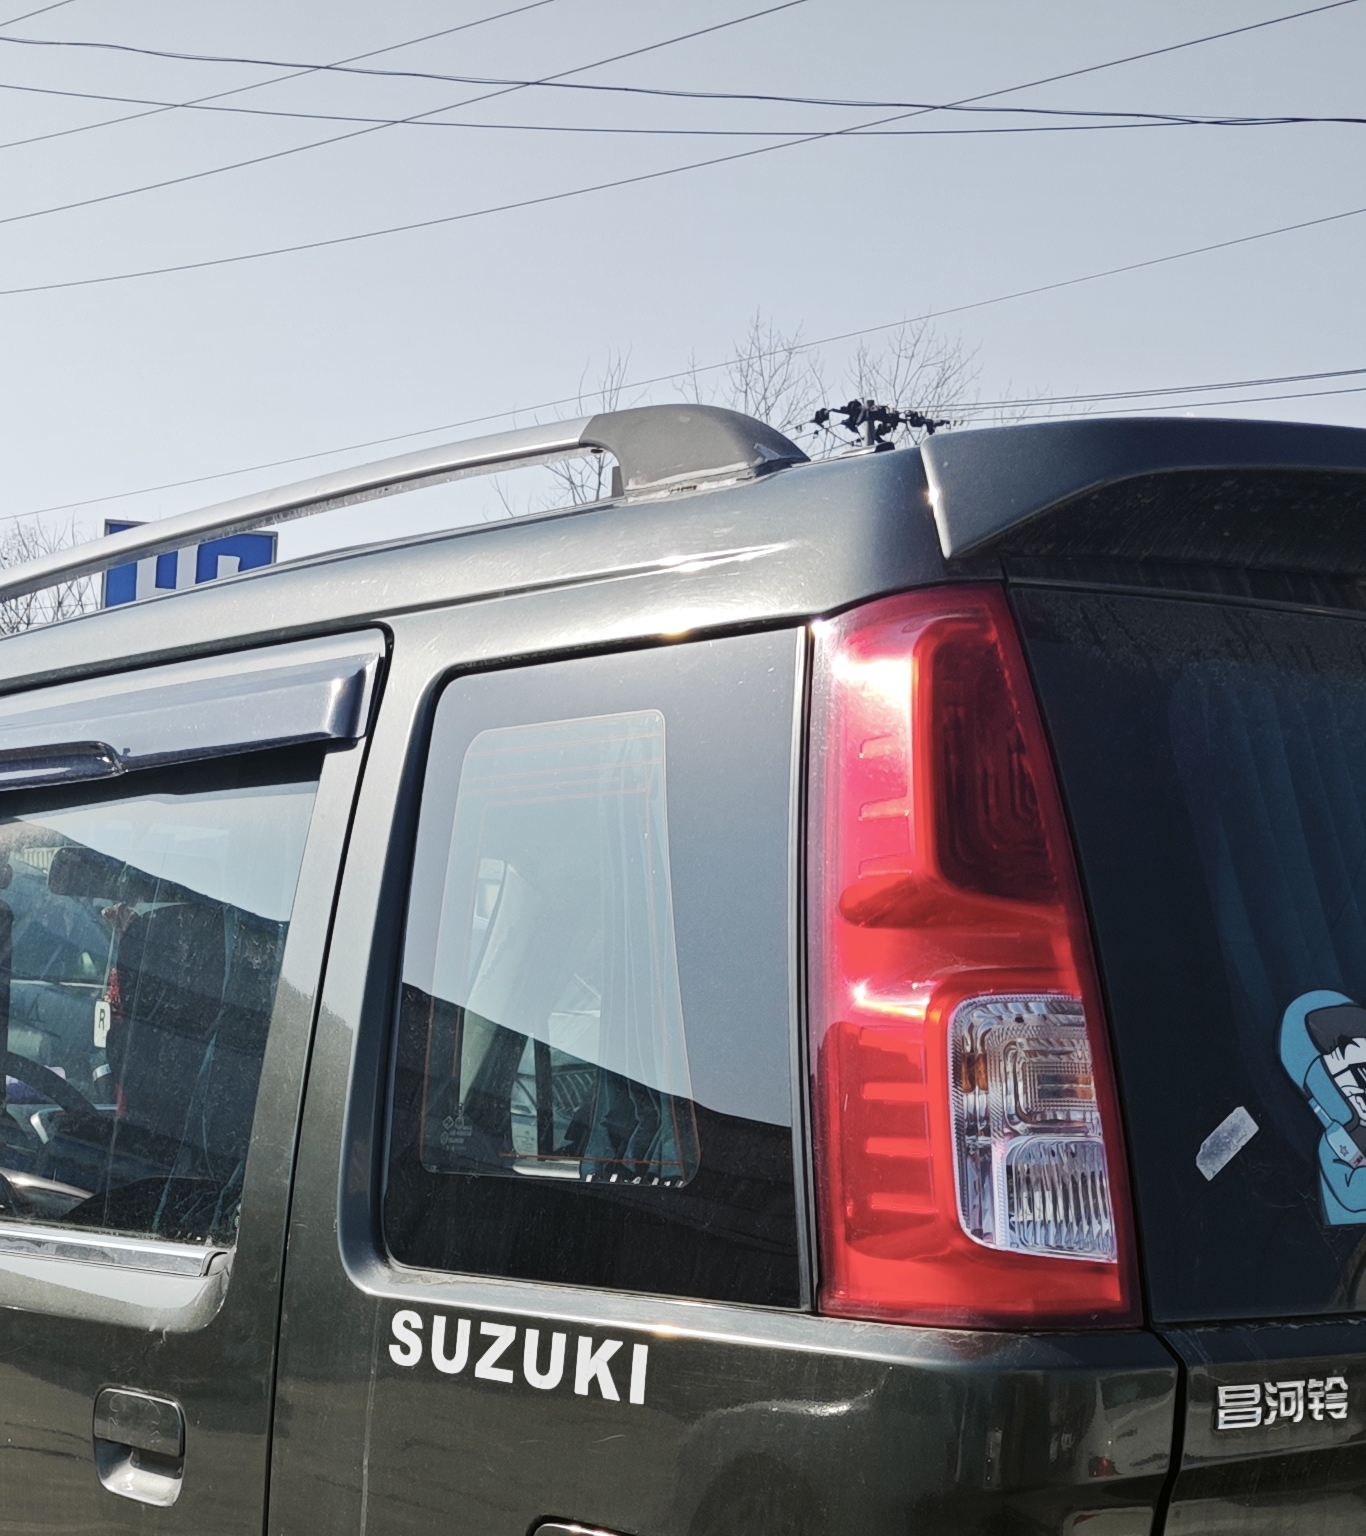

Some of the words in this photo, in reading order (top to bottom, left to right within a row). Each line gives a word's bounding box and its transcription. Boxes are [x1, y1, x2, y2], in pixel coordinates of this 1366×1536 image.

[388, 1309, 649, 1405] SUZUKI
[1217, 1376, 1349, 1430] 昌河铃
